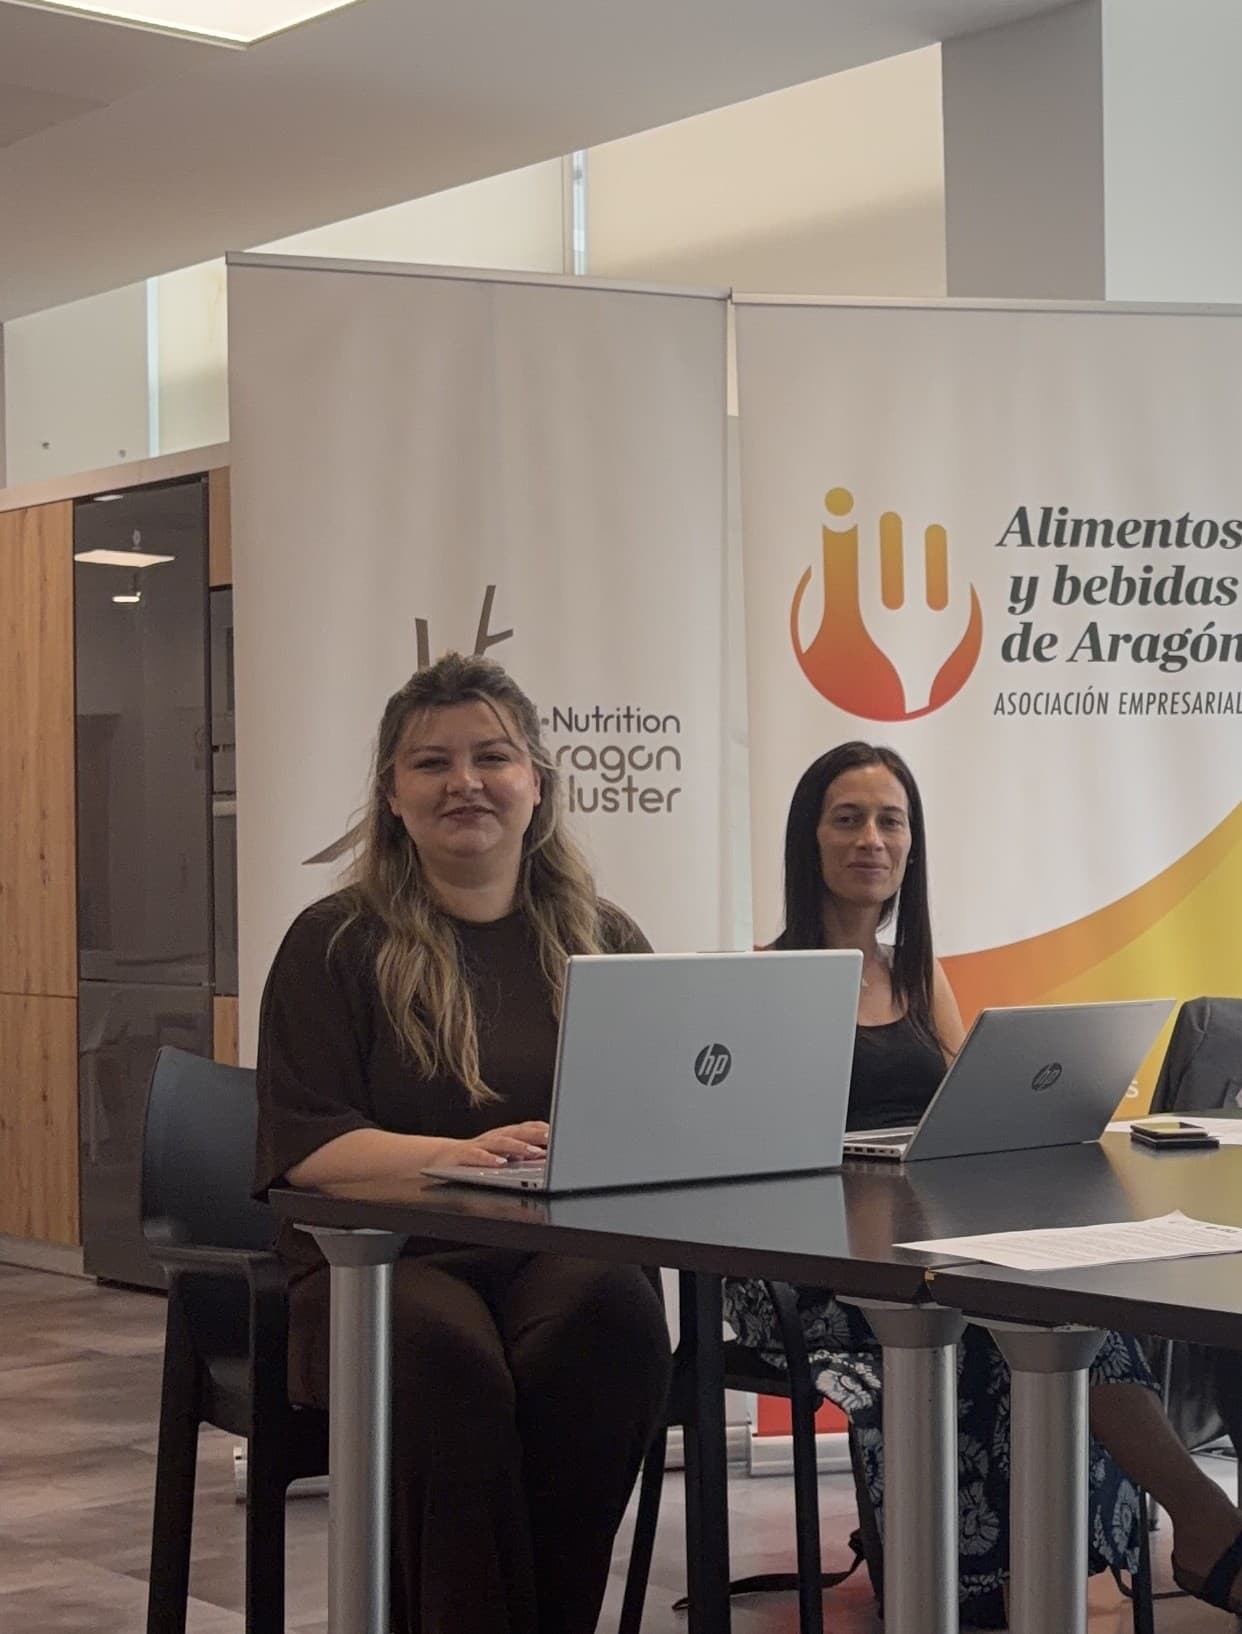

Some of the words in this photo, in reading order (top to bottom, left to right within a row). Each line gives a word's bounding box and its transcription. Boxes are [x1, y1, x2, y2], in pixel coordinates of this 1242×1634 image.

[1007, 575, 1039, 613] y
[1051, 564, 1239, 606] bebidas
[1000, 621, 1058, 663] de
[993, 685, 1109, 716] ASOCIACIÓN
[556, 745, 682, 783] ragon
[568, 774, 682, 813] luster
[698, 1043, 729, 1087] hp
